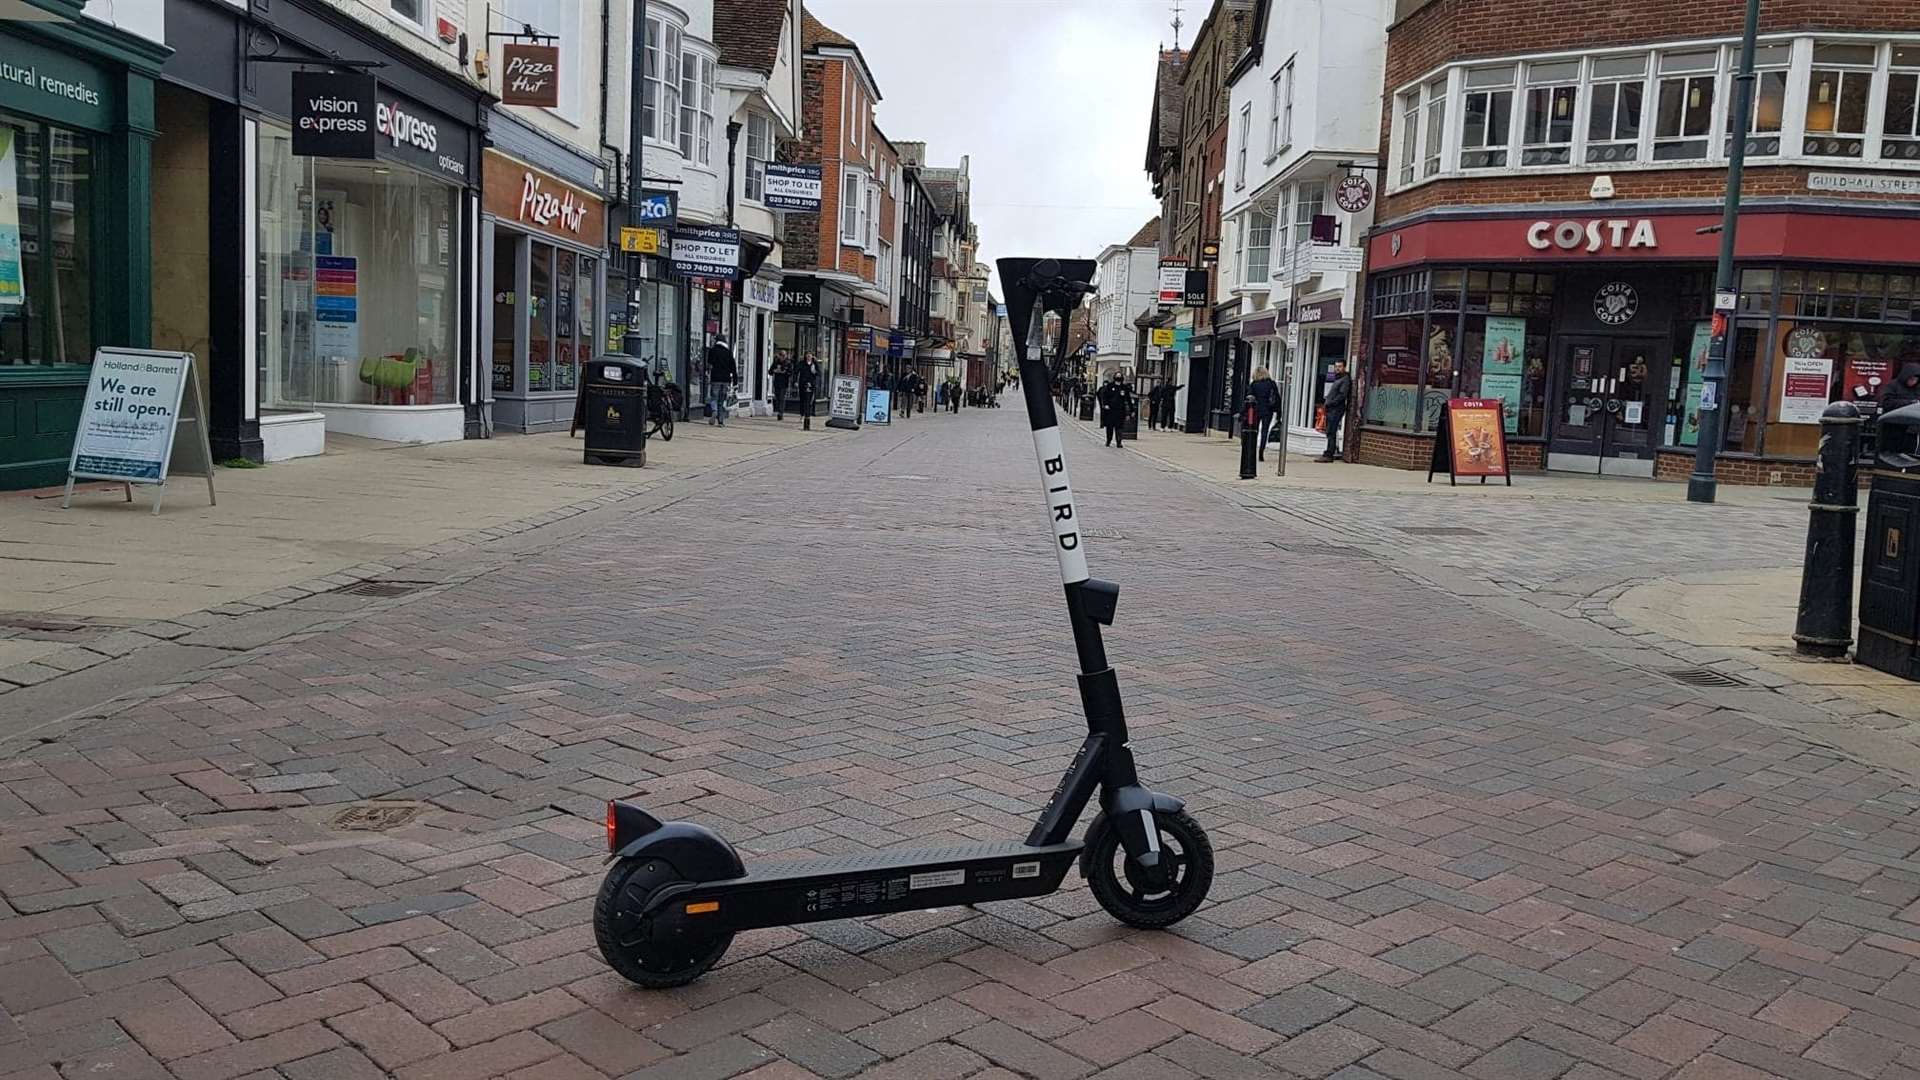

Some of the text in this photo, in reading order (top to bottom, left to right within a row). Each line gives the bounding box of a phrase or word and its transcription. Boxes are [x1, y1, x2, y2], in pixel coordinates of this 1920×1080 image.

[506, 57, 555, 76] Pizza
[0, 62, 99, 106] tural remedies
[511, 77, 547, 93] Hut
[309, 96, 358, 113] vision
[299, 115, 367, 133] express
[376, 101, 438, 153] express
[438, 154, 464, 176] opticians
[767, 164, 806, 174] smithprice
[767, 178, 819, 191] SHOP TO LET
[1341, 179, 1367, 189] COSTA
[1879, 179, 1920, 191] STREET
[519, 171, 588, 234] Pizza Hut
[783, 197, 801, 206] 7409
[801, 199, 818, 207] 2100
[1339, 197, 1368, 210] COFFEE
[1526, 219, 1658, 252] COSTA
[674, 242, 736, 256] SHOP TO LET
[676, 262, 692, 270] 020
[693, 263, 713, 273] 7409
[714, 265, 734, 274] 2100
[1187, 293, 1206, 301] SOLE
[1601, 283, 1632, 296] COSTA
[1597, 307, 1635, 323] COFFEE
[1794, 328, 1820, 339] COSTA
[103, 361, 139, 372] Holland
[145, 364, 178, 375] Barrett
[101, 377, 157, 397] We are
[94, 397, 172, 420] still open.
[1044, 454, 1079, 551] BIRD
